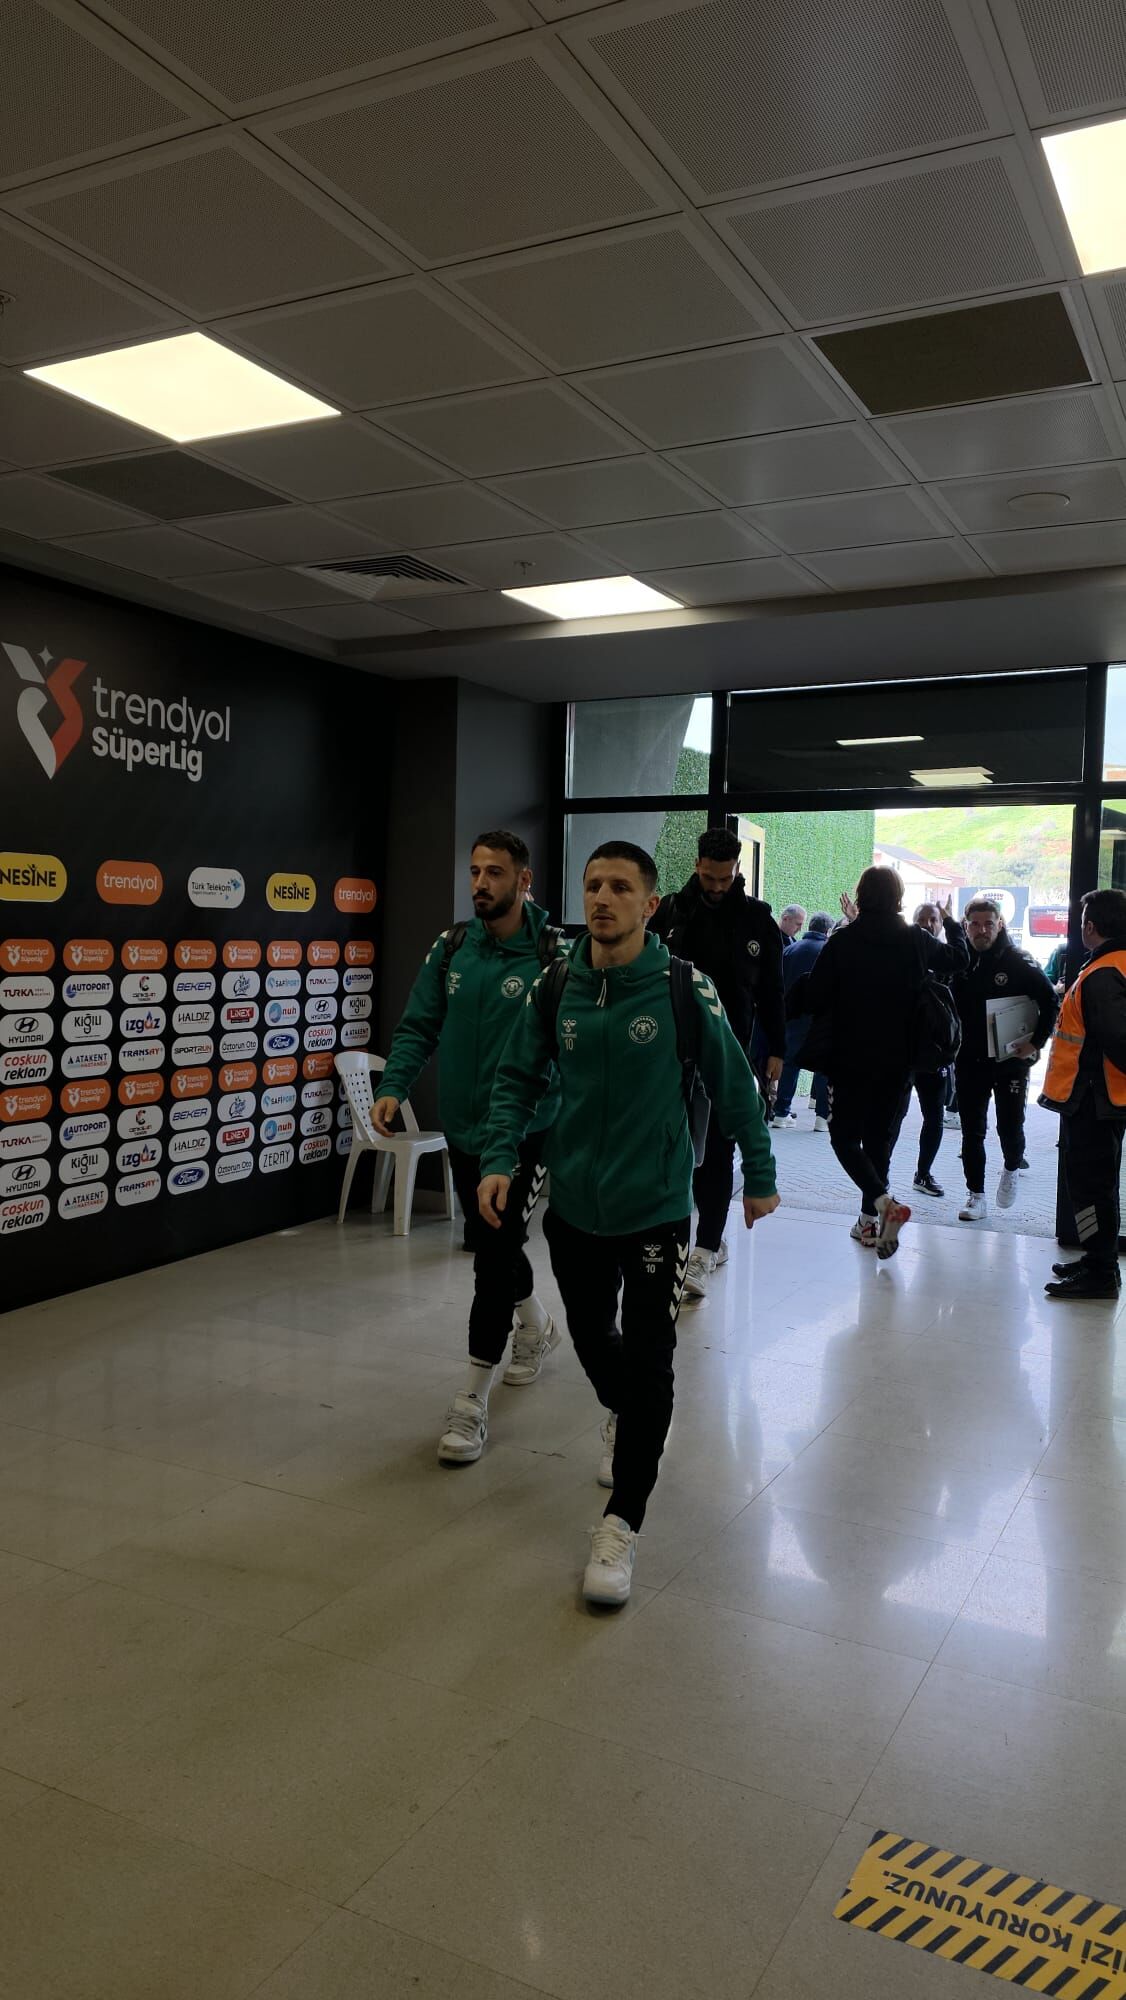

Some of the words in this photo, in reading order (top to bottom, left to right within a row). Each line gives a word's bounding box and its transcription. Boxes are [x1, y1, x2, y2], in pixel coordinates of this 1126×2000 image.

[92, 677, 231, 745] trendyol
[92, 726, 203, 782] SüperLig
[103, 872, 157, 893] trendyol
[192, 882, 205, 891] Türk
[206, 882, 232, 892] Telekom
[338, 888, 375, 904] trendyol
[3, 989, 34, 997] TURKA
[72, 983, 110, 992] AUTOPORT
[176, 982, 212, 992] BEKER
[178, 1012, 210, 1022] HALDIZ
[282, 1007, 297, 1016] nuh
[8, 1034, 44, 1044] HYUNDAI
[272, 1036, 292, 1048] Ford
[307, 1038, 333, 1048] reklam
[564, 1038, 574, 1051] 10
[75, 1053, 107, 1063] ATAKENT
[121, 1048, 160, 1058] TRANSAY
[4, 1067, 47, 1081] reklam
[173, 1108, 208, 1121] BEKER
[69, 1121, 107, 1133] AUTOPORT
[277, 1122, 292, 1132] nuh
[1, 1137, 31, 1148] TURKA
[174, 1138, 206, 1151] HALDIZ
[263, 1150, 290, 1168] ZERAY
[303, 1148, 328, 1161] reklam
[177, 1169, 202, 1184] Ford
[6, 1180, 41, 1193] HYUNDAI
[118, 1180, 156, 1192] TRANSAY
[72, 1191, 104, 1205] ATAKENT
[2, 1212, 44, 1230] reklam
[645, 1263, 656, 1274] 10
[883, 1871, 1073, 1952] KORUYUNUZ.
